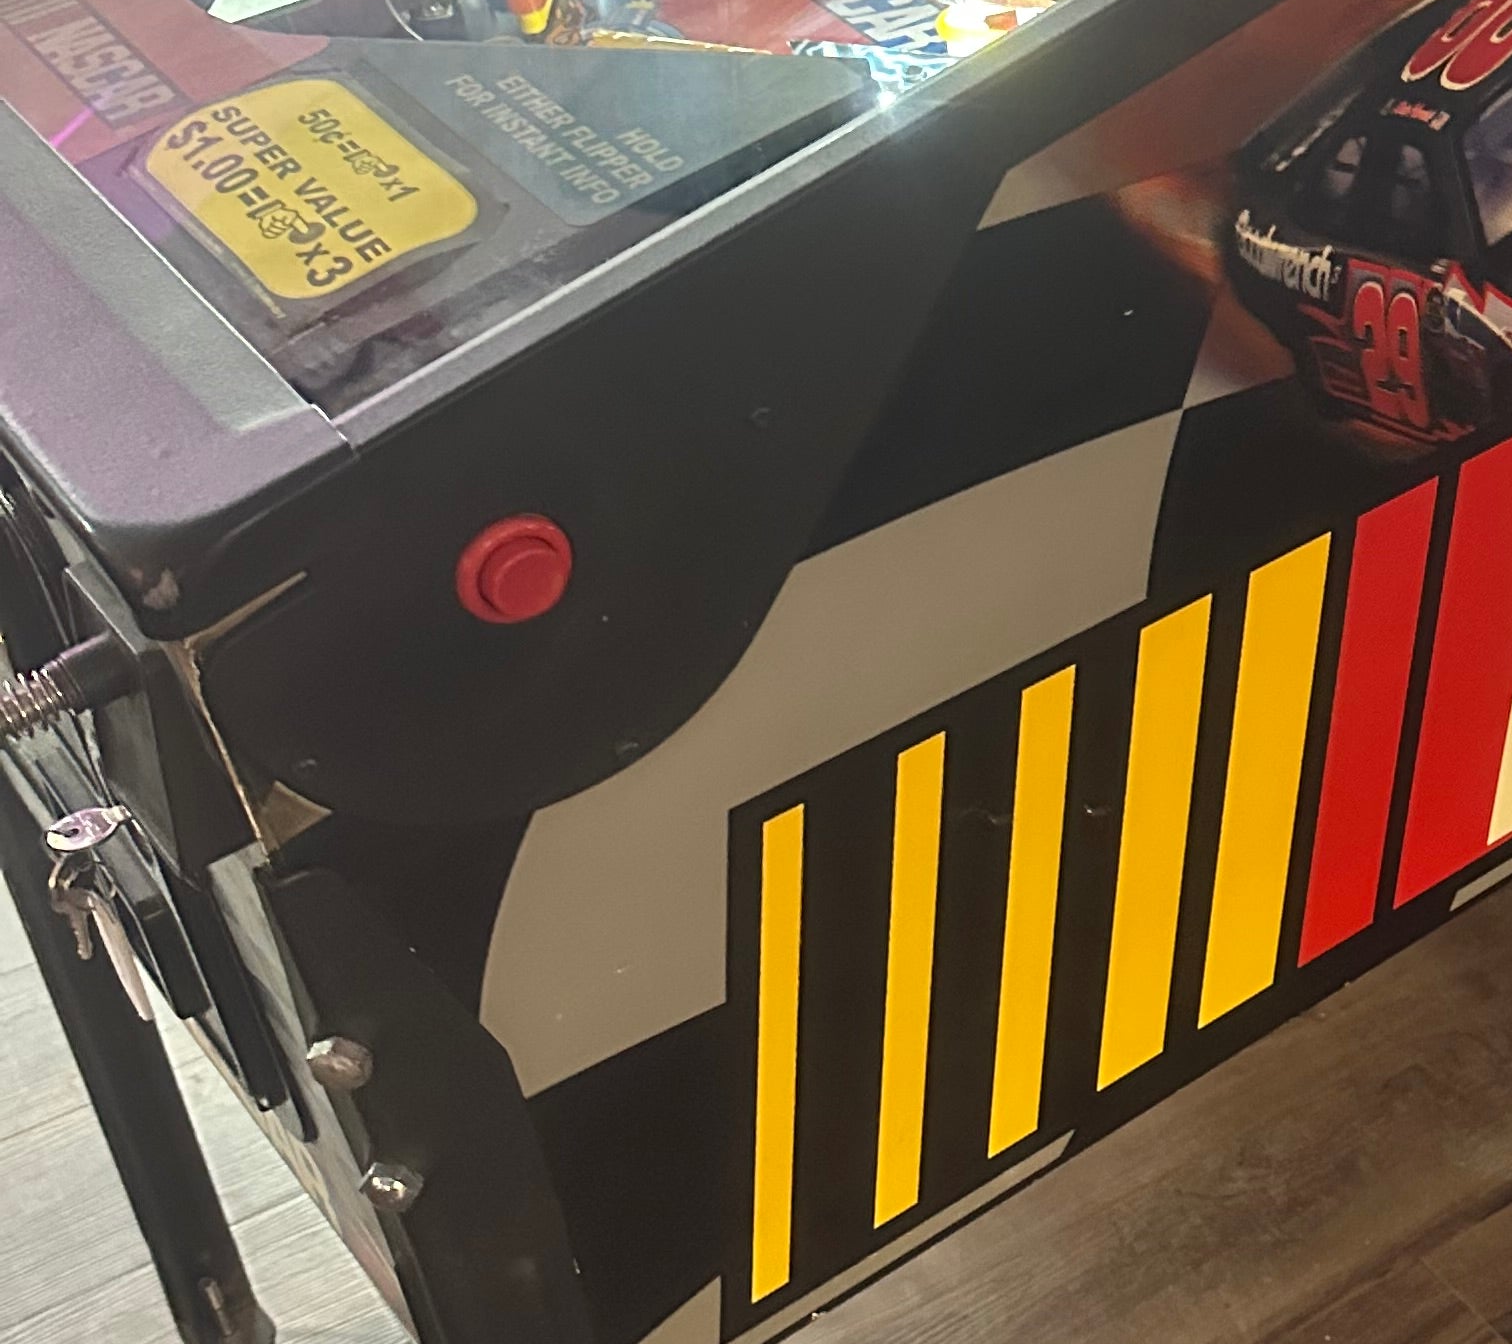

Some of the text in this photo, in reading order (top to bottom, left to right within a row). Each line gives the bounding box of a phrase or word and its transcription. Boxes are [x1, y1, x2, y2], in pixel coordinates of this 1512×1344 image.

[26, 16, 176, 121] NASCAR
[496, 72, 655, 190] EITHER FLIPPER
[211, 105, 392, 263] SUPER VALUE
[444, 73, 621, 205] FOR INSTANT INFO
[616, 126, 684, 173] HOLD
[1354, 280, 1429, 428] 29
